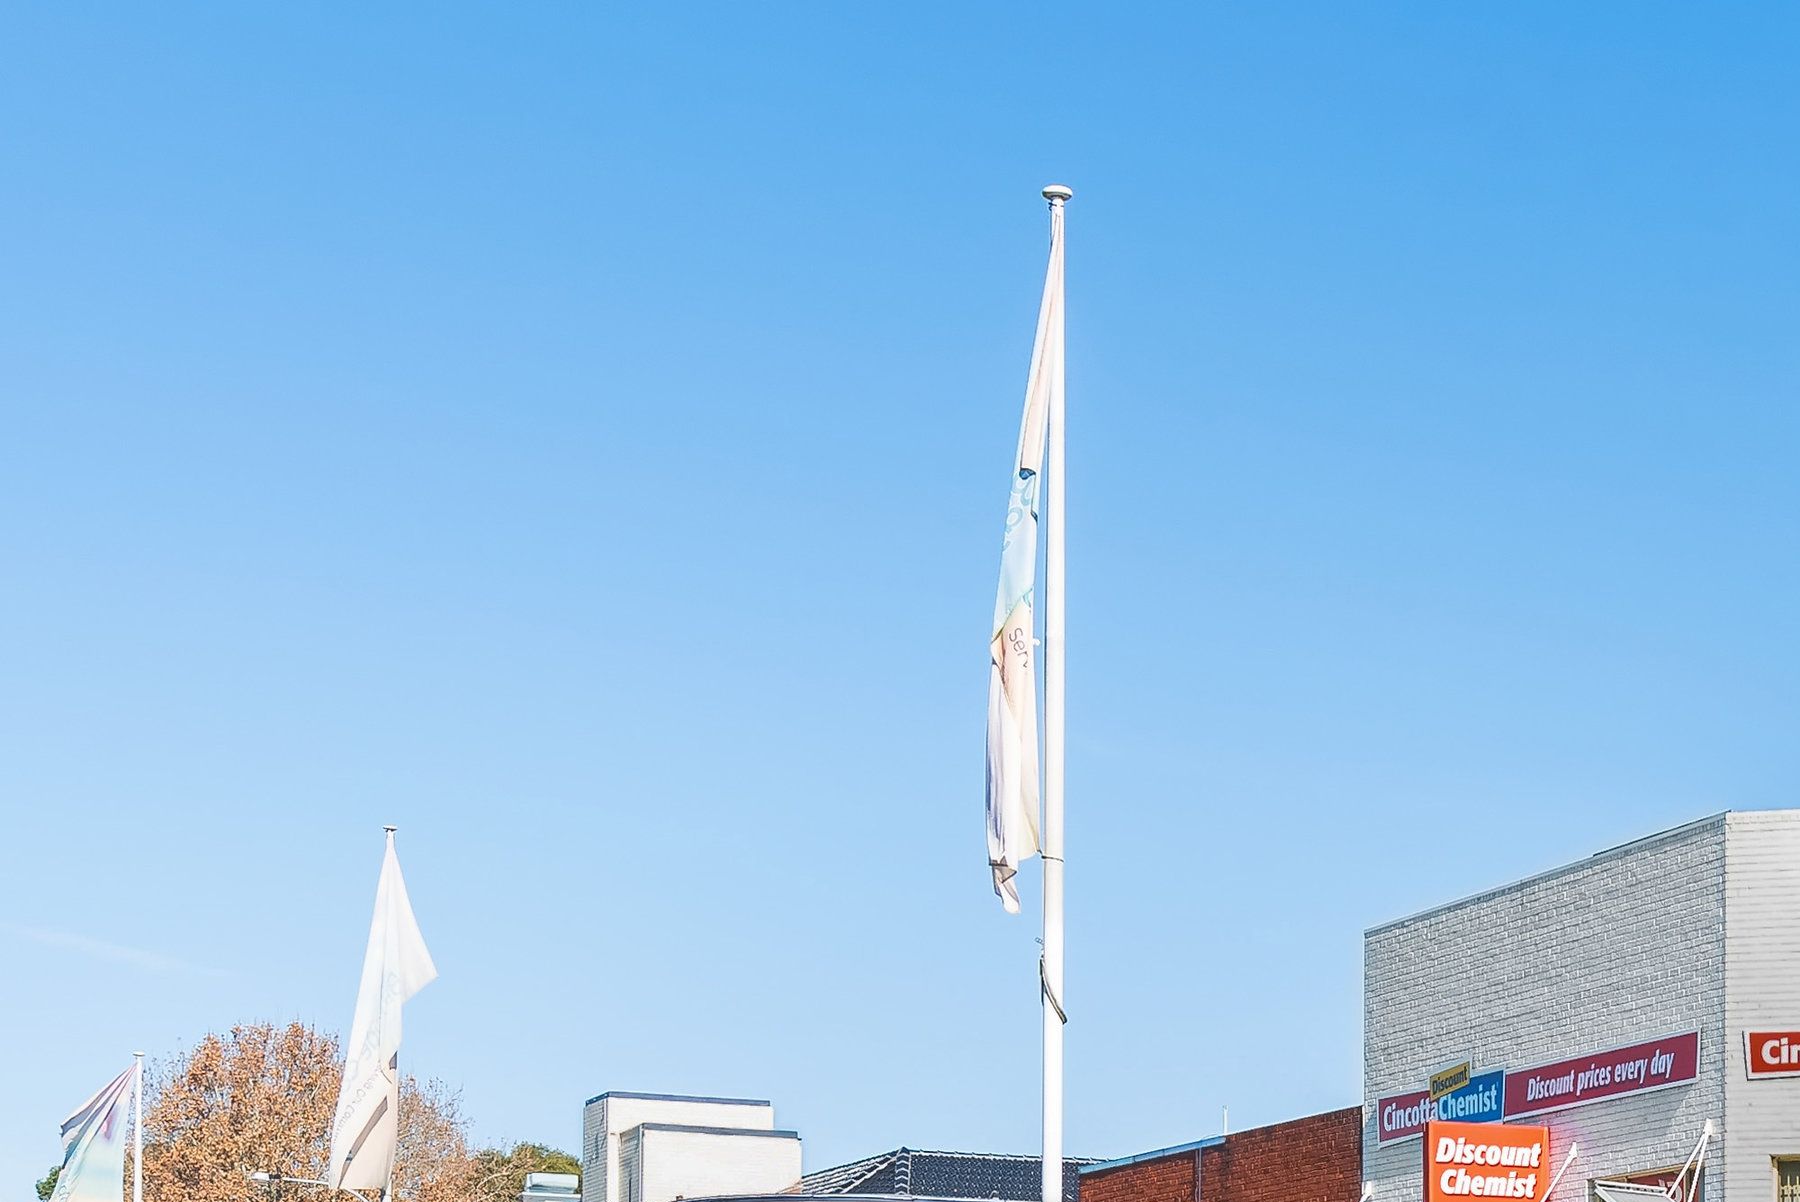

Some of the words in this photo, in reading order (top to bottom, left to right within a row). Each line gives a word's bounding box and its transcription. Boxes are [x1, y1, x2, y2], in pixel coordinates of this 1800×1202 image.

[1431, 1065, 1469, 1092] Discount
[1527, 1072, 1574, 1101] Discount
[1576, 1065, 1611, 1096] prices
[1615, 1057, 1648, 1084] every
[1650, 1049, 1675, 1083] day
[1383, 1086, 1498, 1132] CincottaChemist
[1435, 1136, 1541, 1168] Discount
[1440, 1169, 1537, 1198] Chemist
